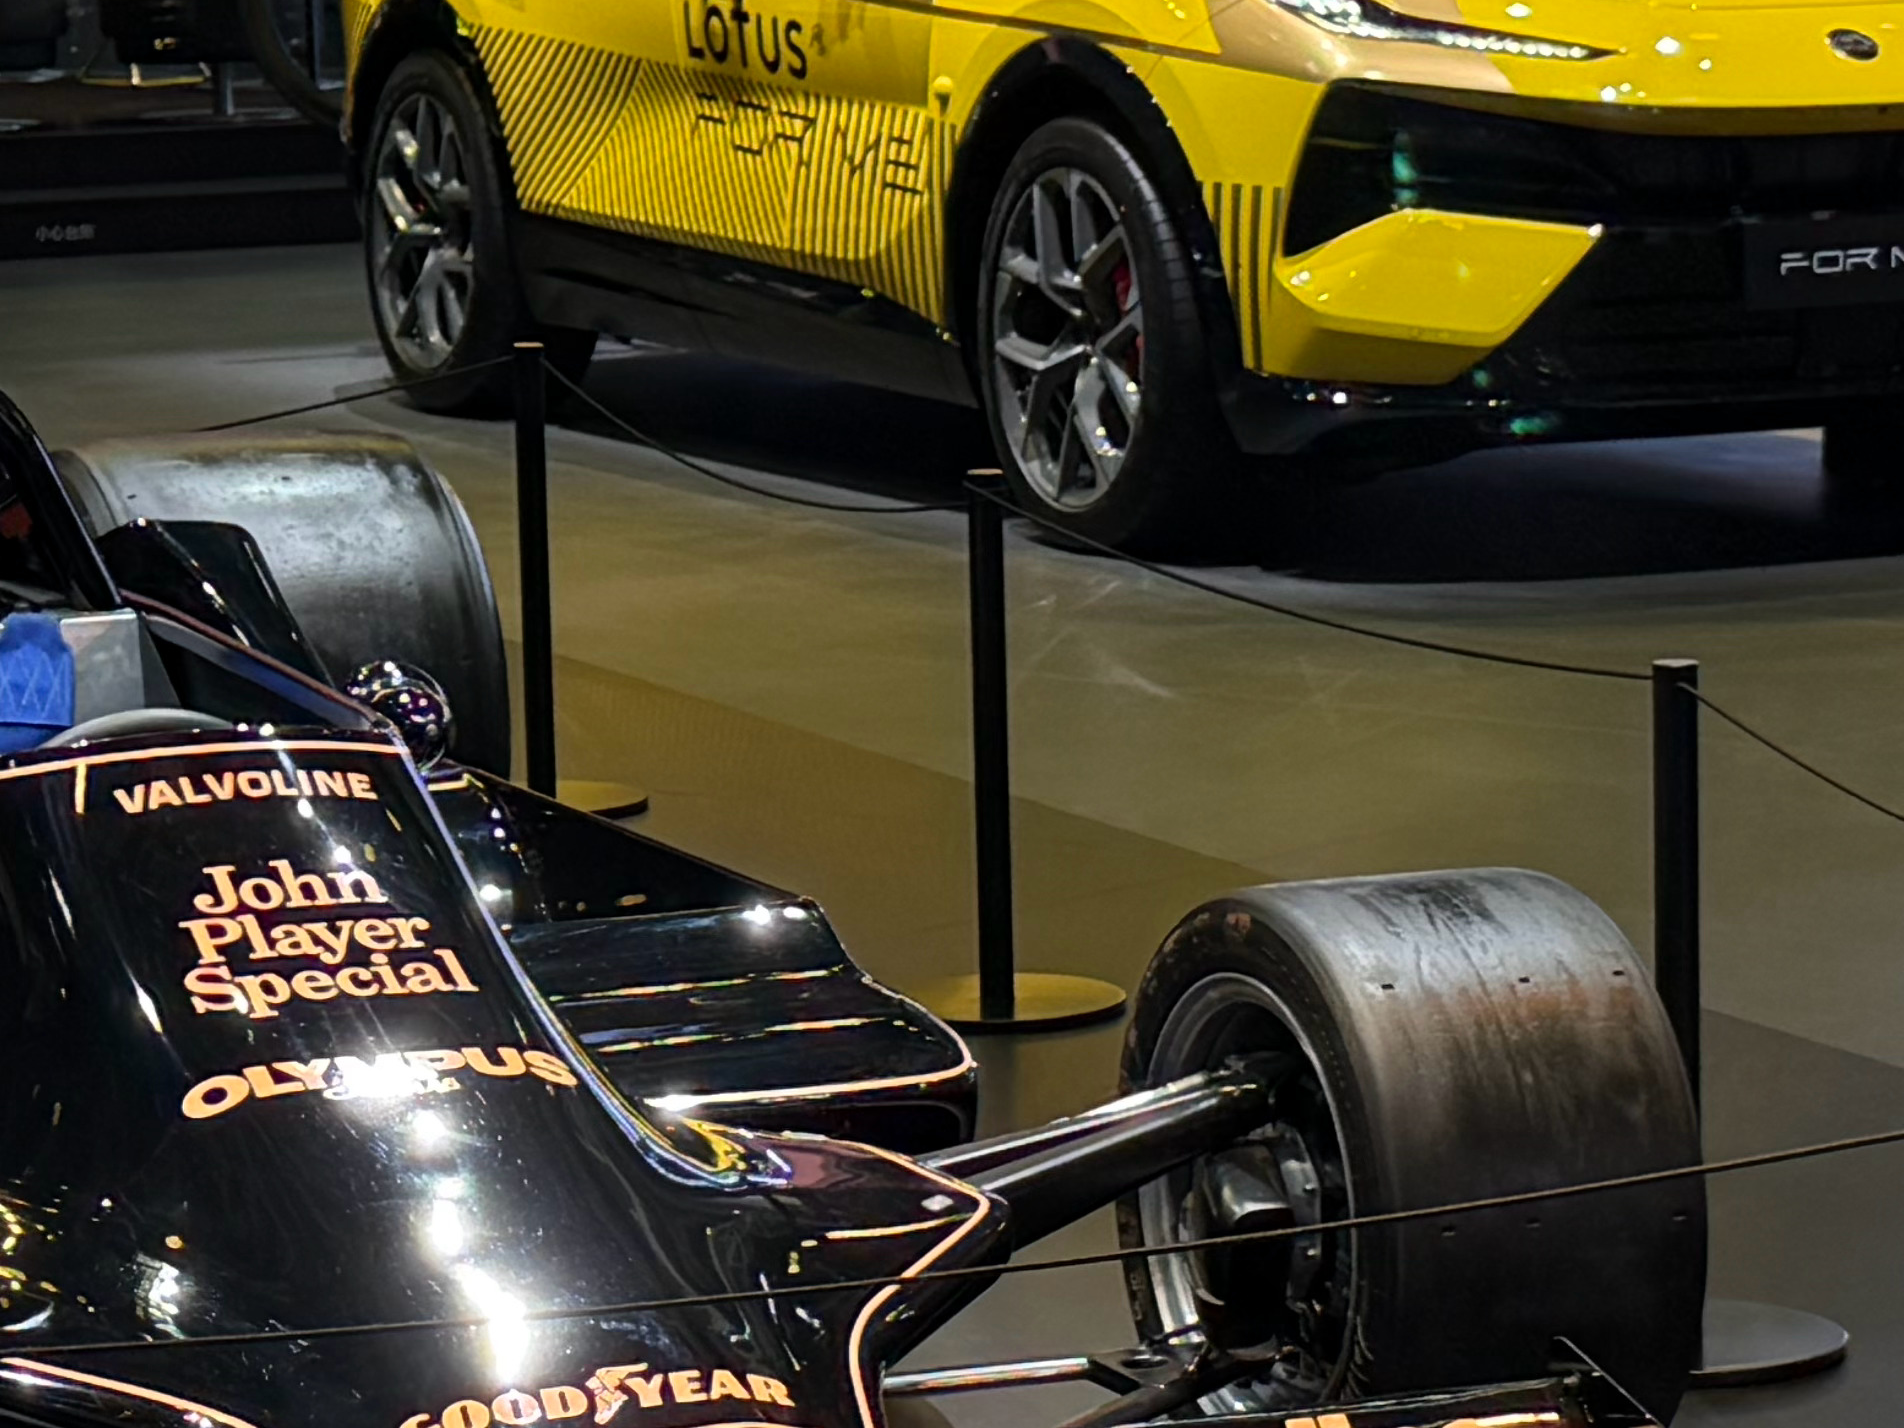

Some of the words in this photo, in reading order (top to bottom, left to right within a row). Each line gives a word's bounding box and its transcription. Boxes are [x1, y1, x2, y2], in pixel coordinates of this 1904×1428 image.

[1780, 245, 1881, 276] FOR
[113, 768, 379, 814] VALVOLINE
[194, 859, 389, 915] John
[178, 914, 431, 965] Player
[183, 948, 480, 1019] Special
[182, 1046, 579, 1119] OLYMPUS
